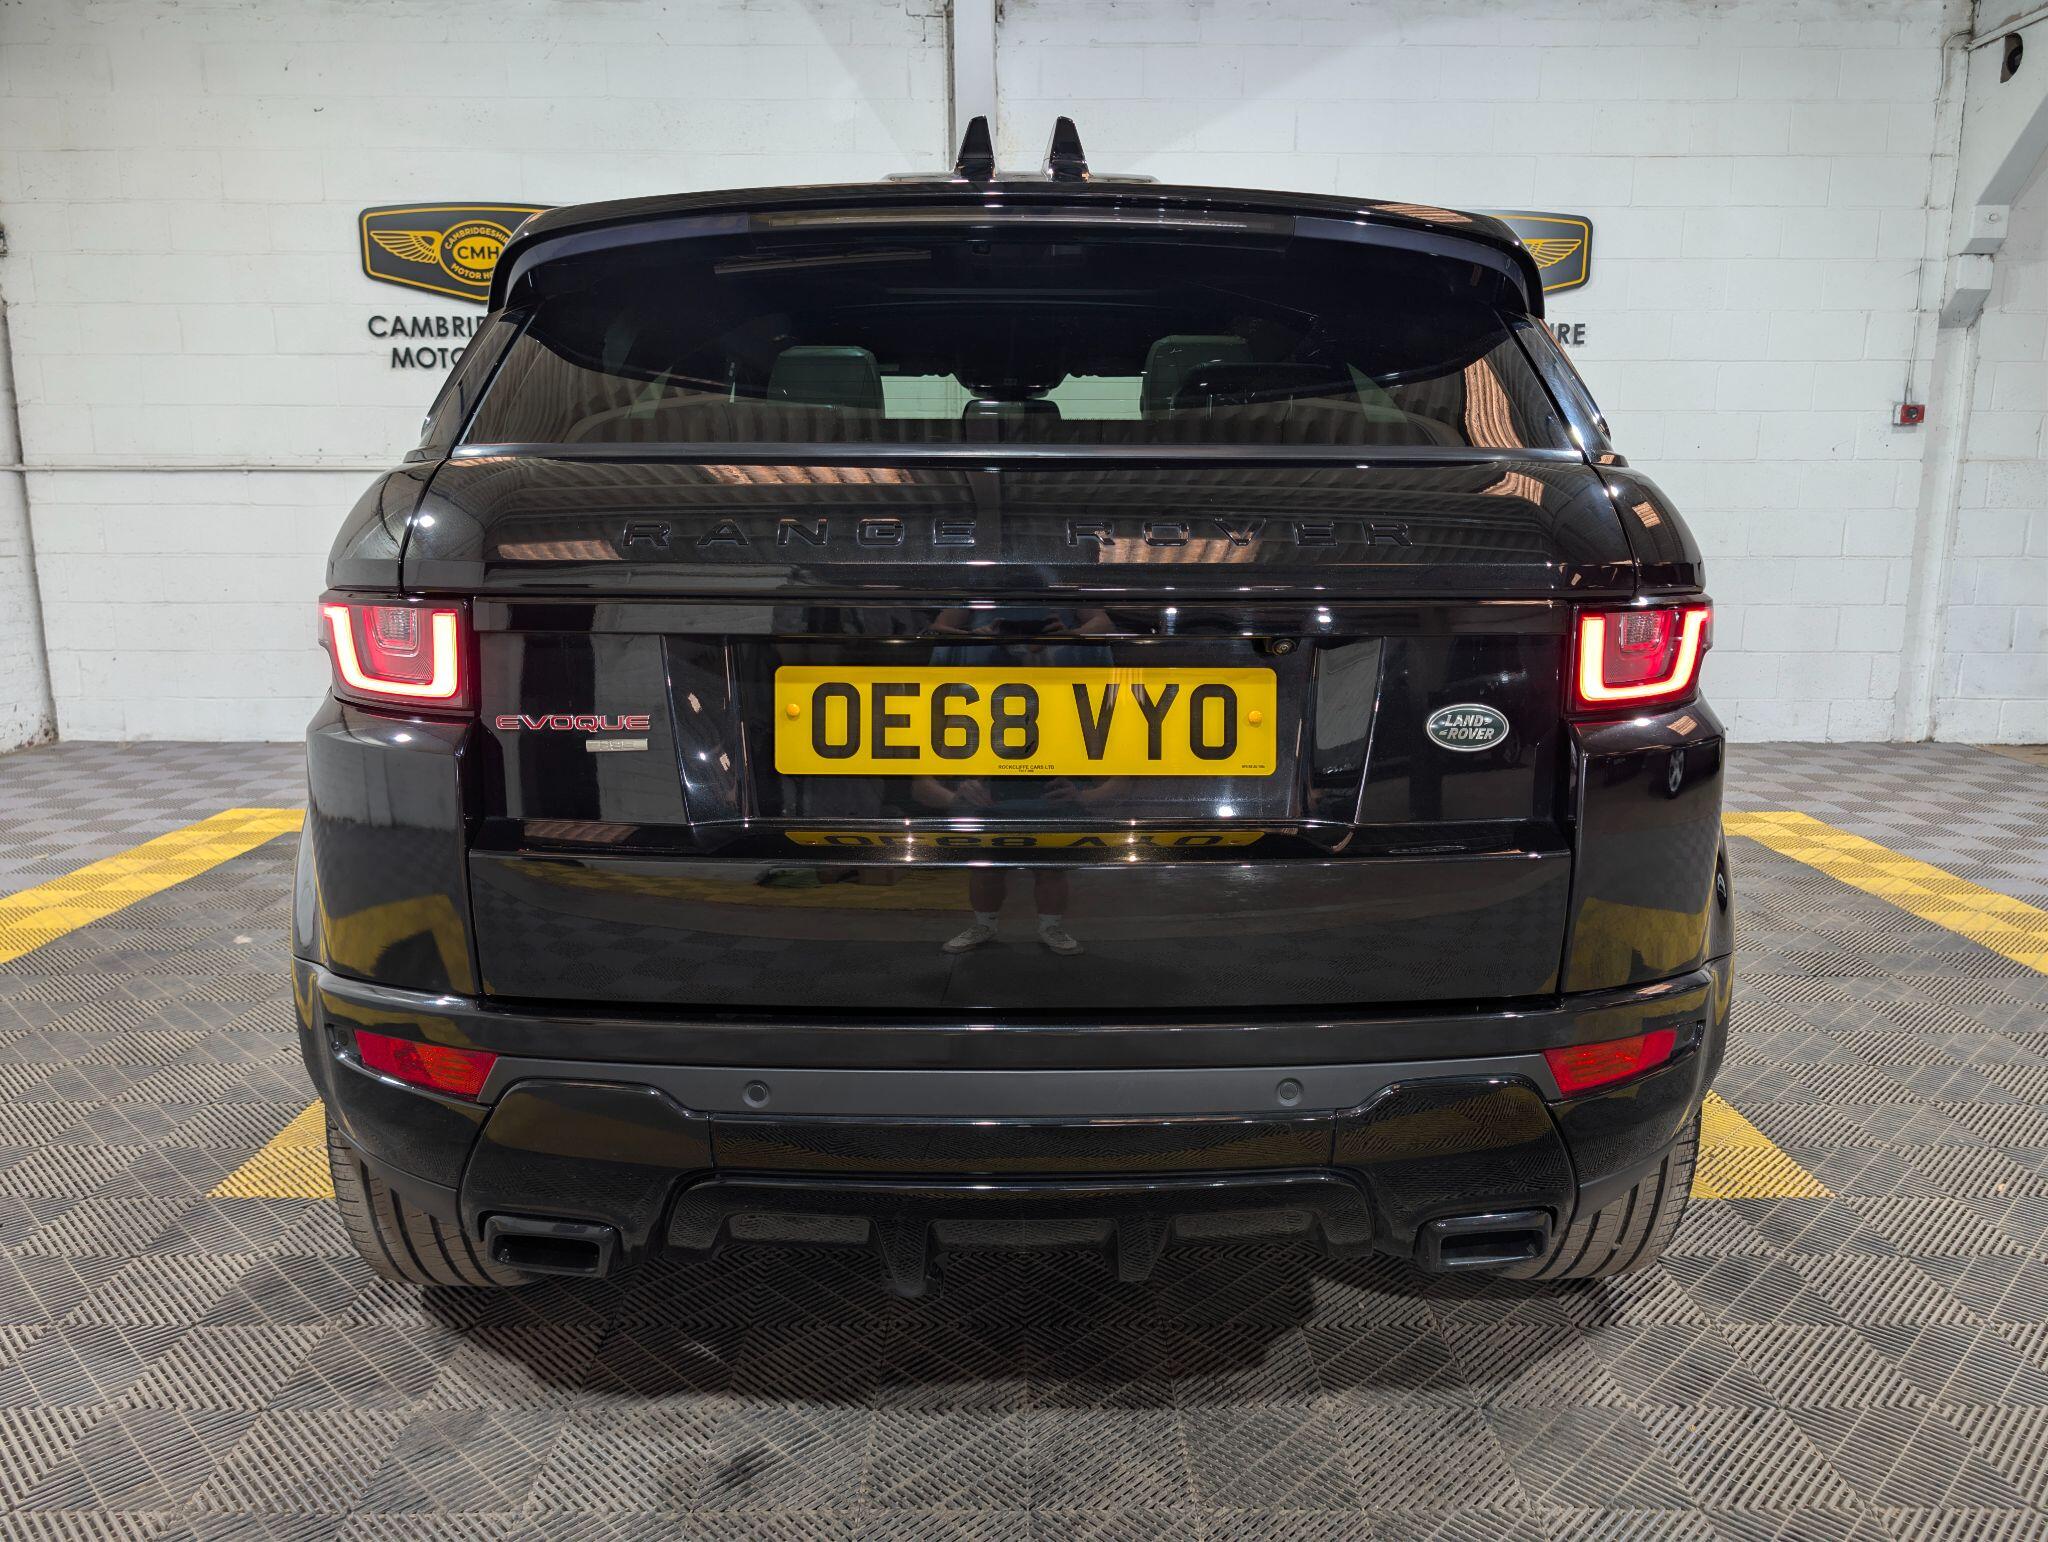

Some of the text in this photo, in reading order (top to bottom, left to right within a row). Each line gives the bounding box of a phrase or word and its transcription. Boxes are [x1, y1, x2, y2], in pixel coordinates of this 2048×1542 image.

[457, 246, 499, 259] CMH
[450, 263, 482, 279] MOTOR
[1549, 323, 1586, 344] RE
[622, 517, 1413, 547] RANGE ROVER
[496, 715, 650, 732] EVOQUE
[811, 682, 1238, 760] OE68 VYO
[1445, 714, 1484, 727] LAND
[1446, 728, 1495, 740] ROVER
